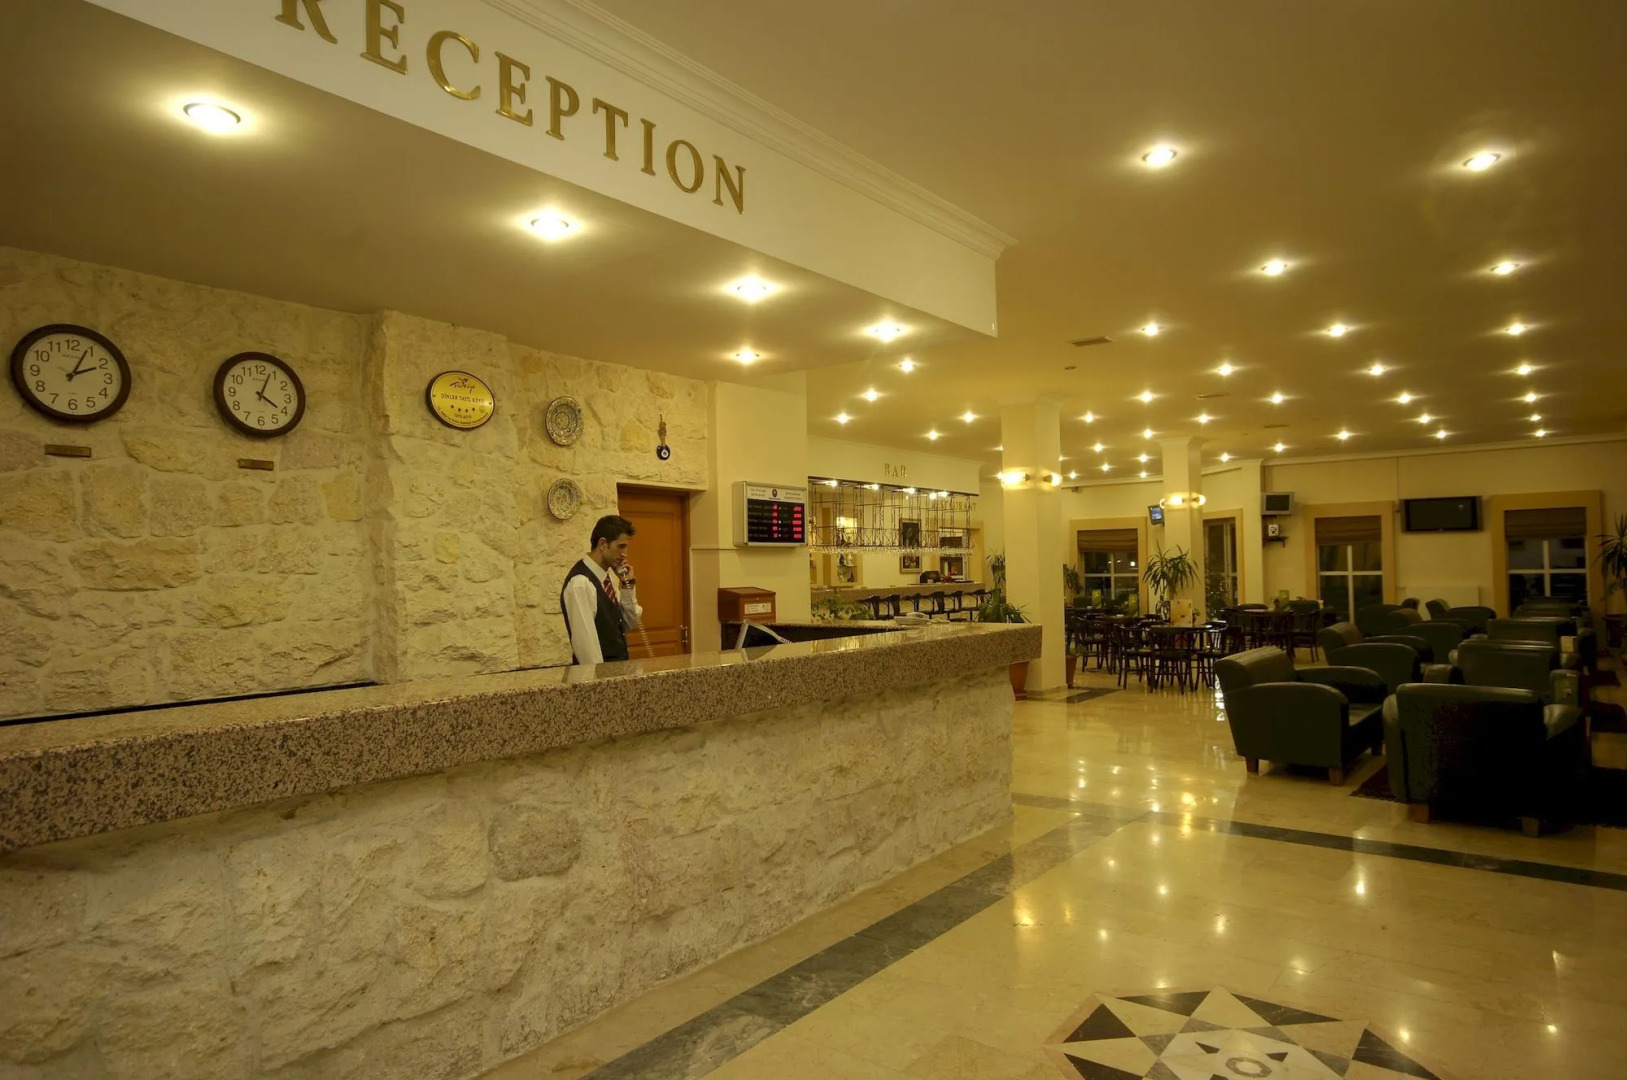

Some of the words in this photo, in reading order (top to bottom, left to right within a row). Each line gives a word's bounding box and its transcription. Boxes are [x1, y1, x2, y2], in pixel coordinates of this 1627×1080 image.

[48, 340, 61, 352] 11
[65, 339, 80, 351] 12
[34, 350, 50, 362] 10
[87, 345, 94, 357] 1
[99, 358, 108, 369] 2
[30, 364, 40, 376] 9
[241, 367, 252, 376] 11
[254, 365, 266, 375] 12
[272, 371, 277, 380] 1
[103, 373, 113, 384] 3
[231, 374, 244, 385] 10
[35, 380, 46, 392] 8
[280, 381, 288, 391] 2
[98, 387, 108, 398] 4
[228, 387, 236, 397] 9
[49, 393, 59, 404] 7
[86, 396, 96, 408] 5
[284, 394, 292, 404] 3
[68, 399, 78, 410] 6
[232, 400, 241, 411] 8
[243, 411, 251, 421] 7
[280, 406, 288, 416] 4
[257, 416, 266, 426] 6
[271, 414, 279, 424] 5
[884, 463, 907, 478] BAR
